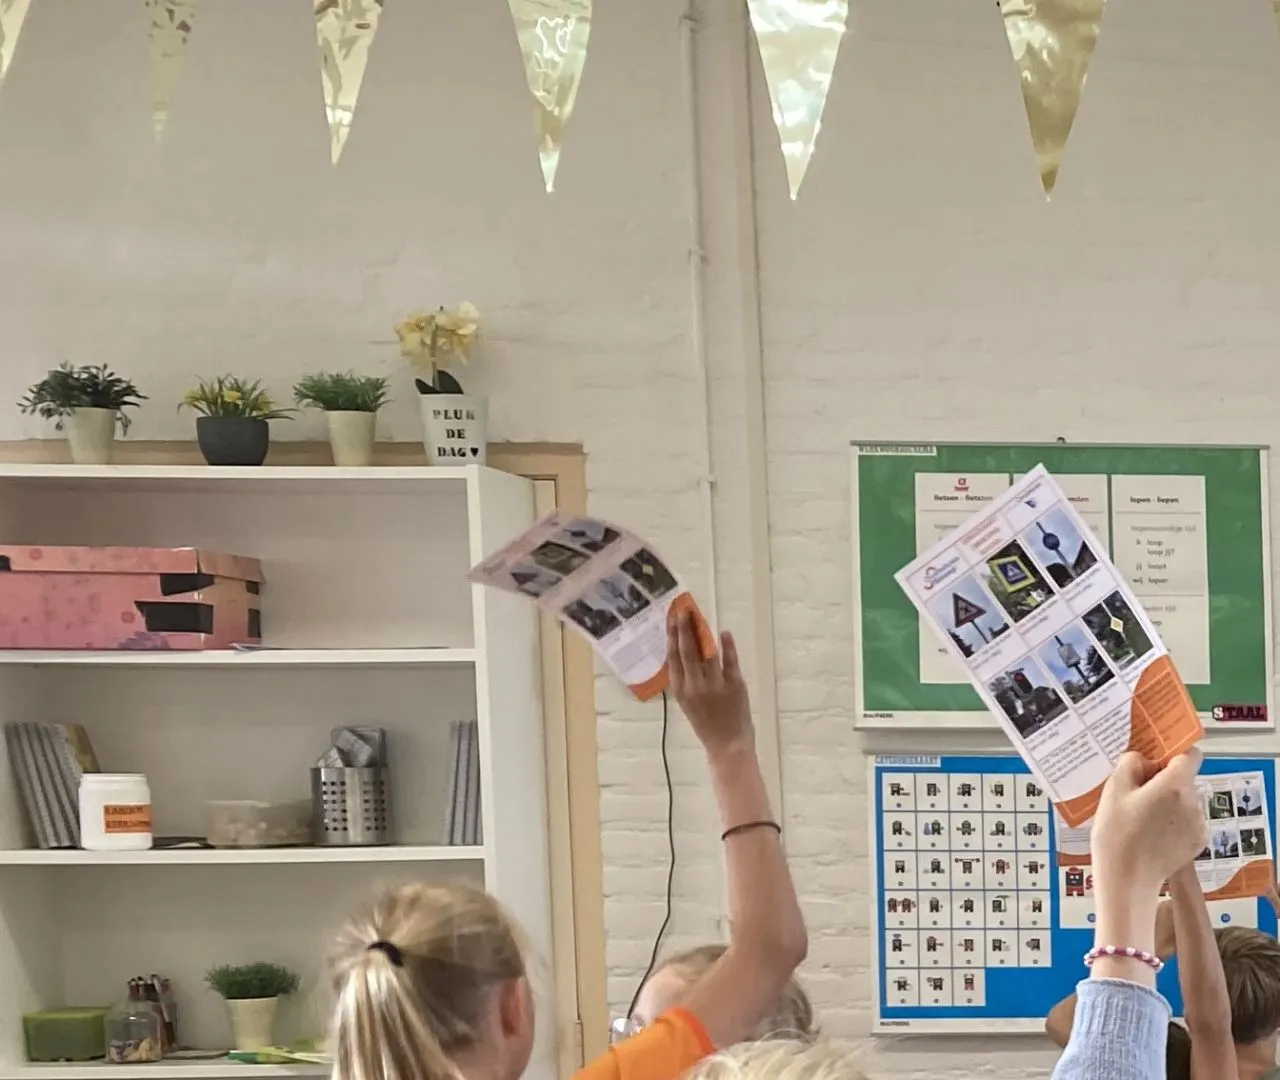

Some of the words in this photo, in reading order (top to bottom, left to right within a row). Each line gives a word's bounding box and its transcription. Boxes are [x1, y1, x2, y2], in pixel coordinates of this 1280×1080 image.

[445, 428, 466, 439] DE
[437, 446, 467, 457] DAG
[1130, 496, 1151, 504] lopen
[1212, 706, 1265, 719] STAAL
